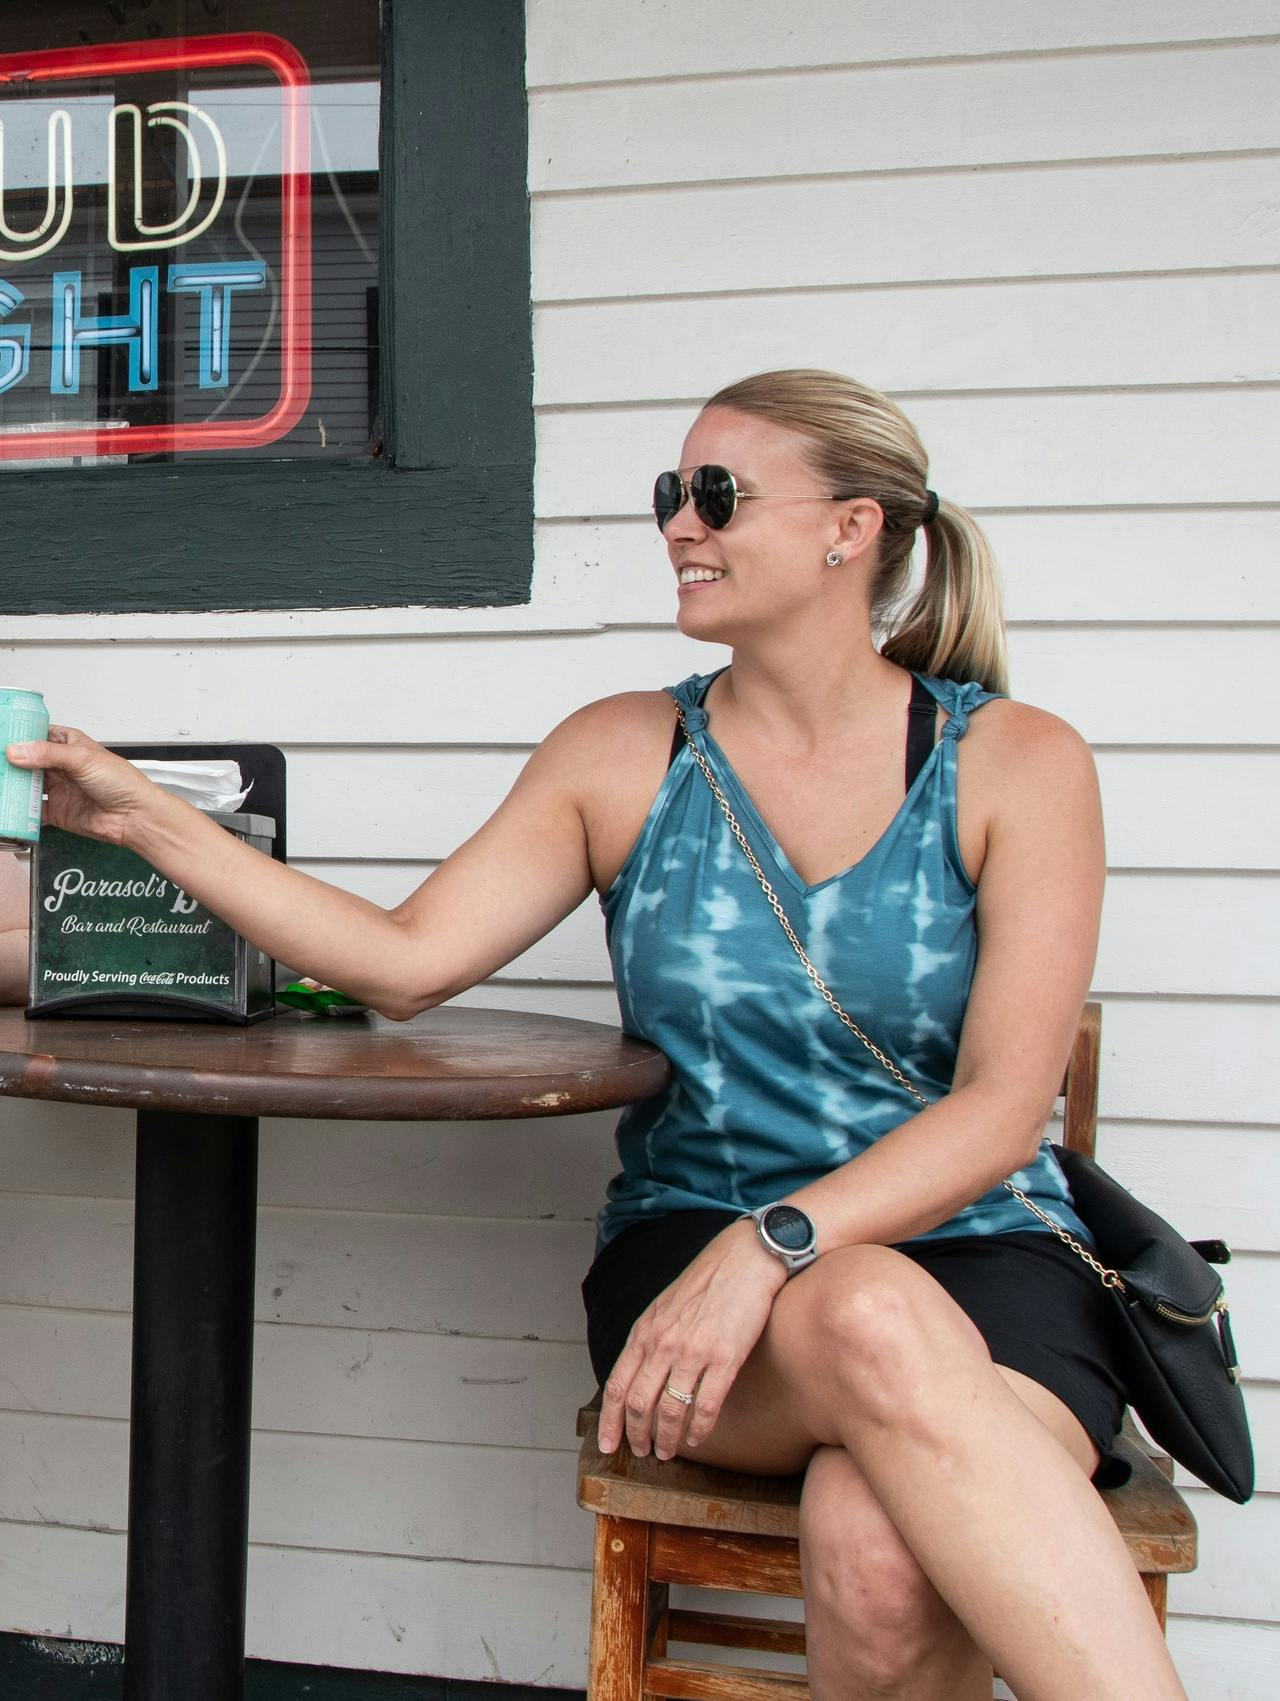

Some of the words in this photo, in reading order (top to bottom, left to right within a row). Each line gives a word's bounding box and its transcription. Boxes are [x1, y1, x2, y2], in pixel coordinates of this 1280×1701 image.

[43, 868, 167, 912] Parasol's
[60, 914, 94, 934] Bar
[95, 917, 126, 934] and
[126, 915, 213, 937] Restaurant
[43, 969, 90, 984] Proudly
[91, 970, 137, 986] Serving
[176, 972, 230, 985] Products
